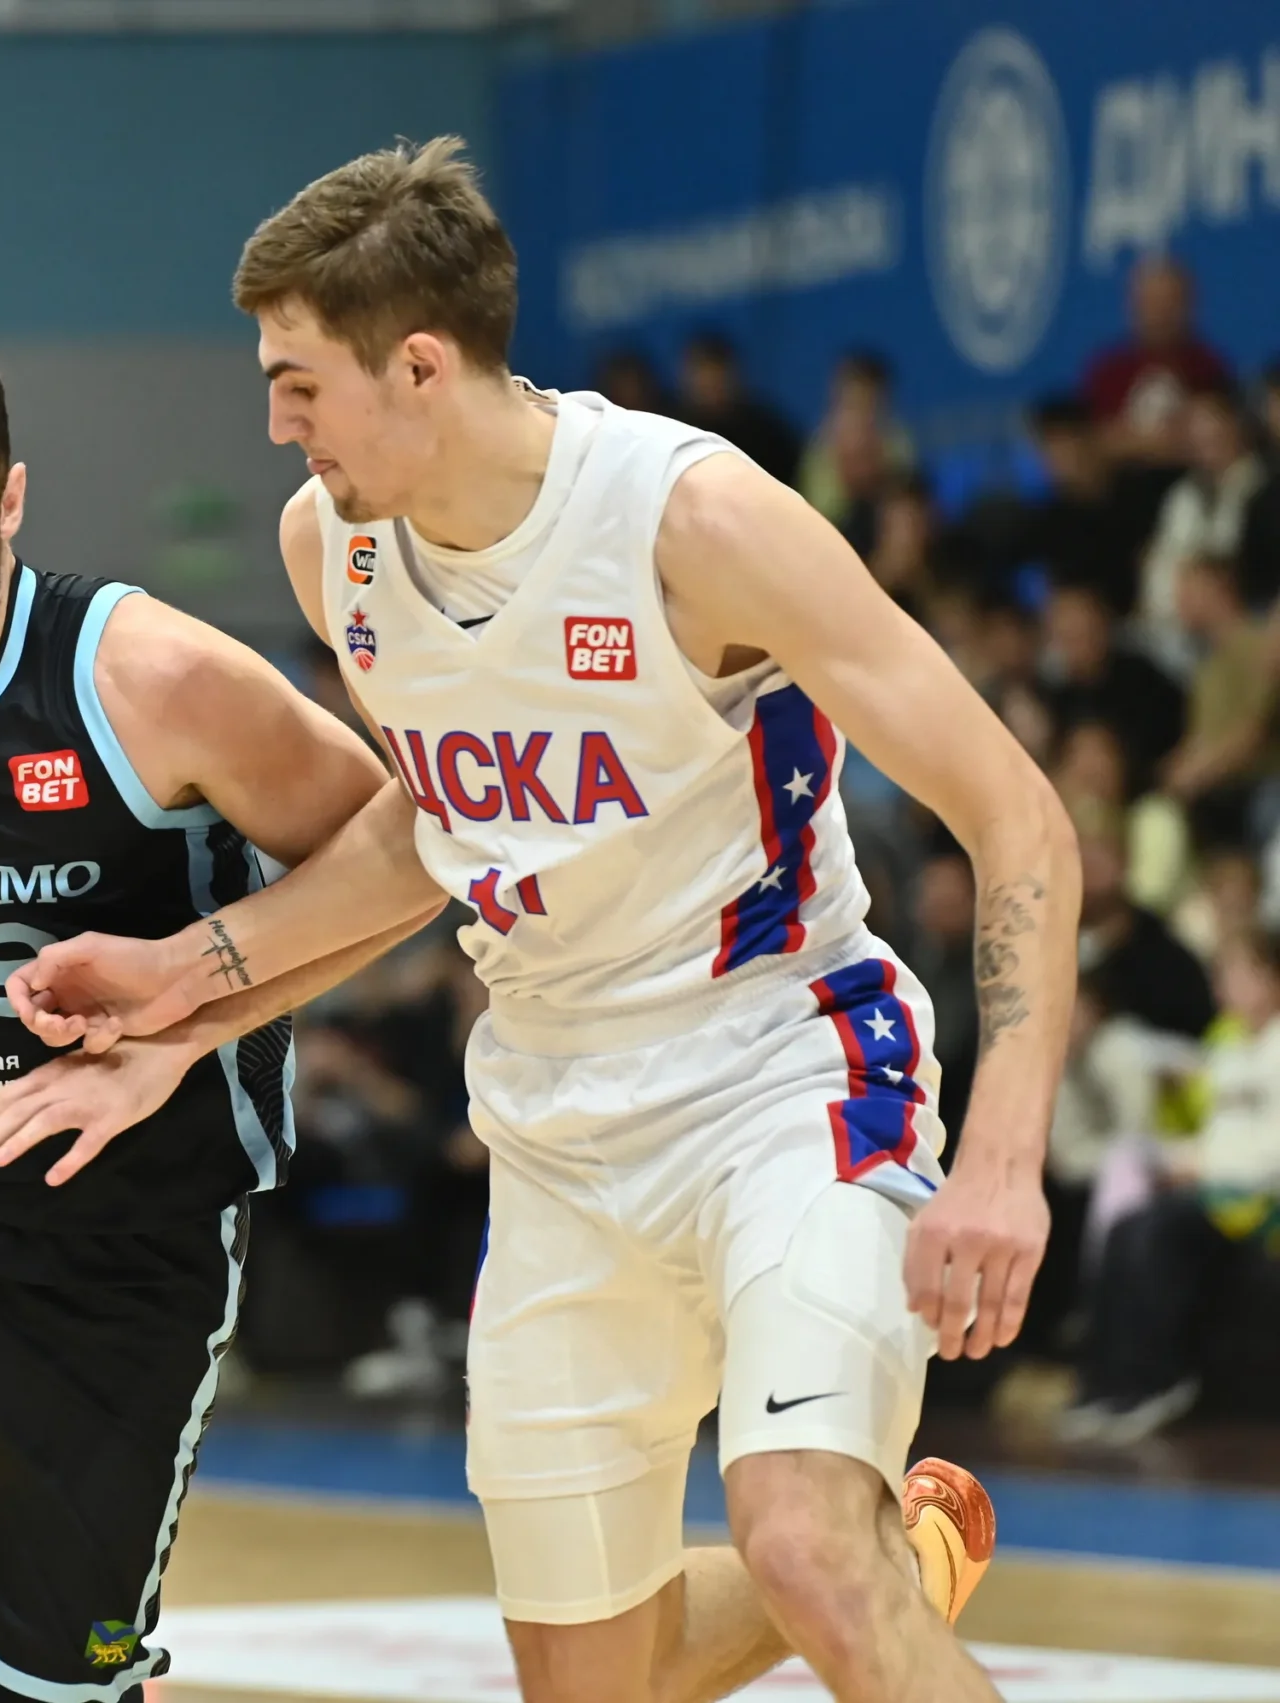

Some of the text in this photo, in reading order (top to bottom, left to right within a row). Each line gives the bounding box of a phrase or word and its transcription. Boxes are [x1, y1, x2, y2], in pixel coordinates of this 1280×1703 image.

[347, 631, 375, 646] CSKA
[569, 624, 628, 648] FON
[570, 648, 631, 673] BET
[17, 756, 74, 782] FON
[381, 725, 650, 835] ЦСКА
[22, 778, 80, 804] BET
